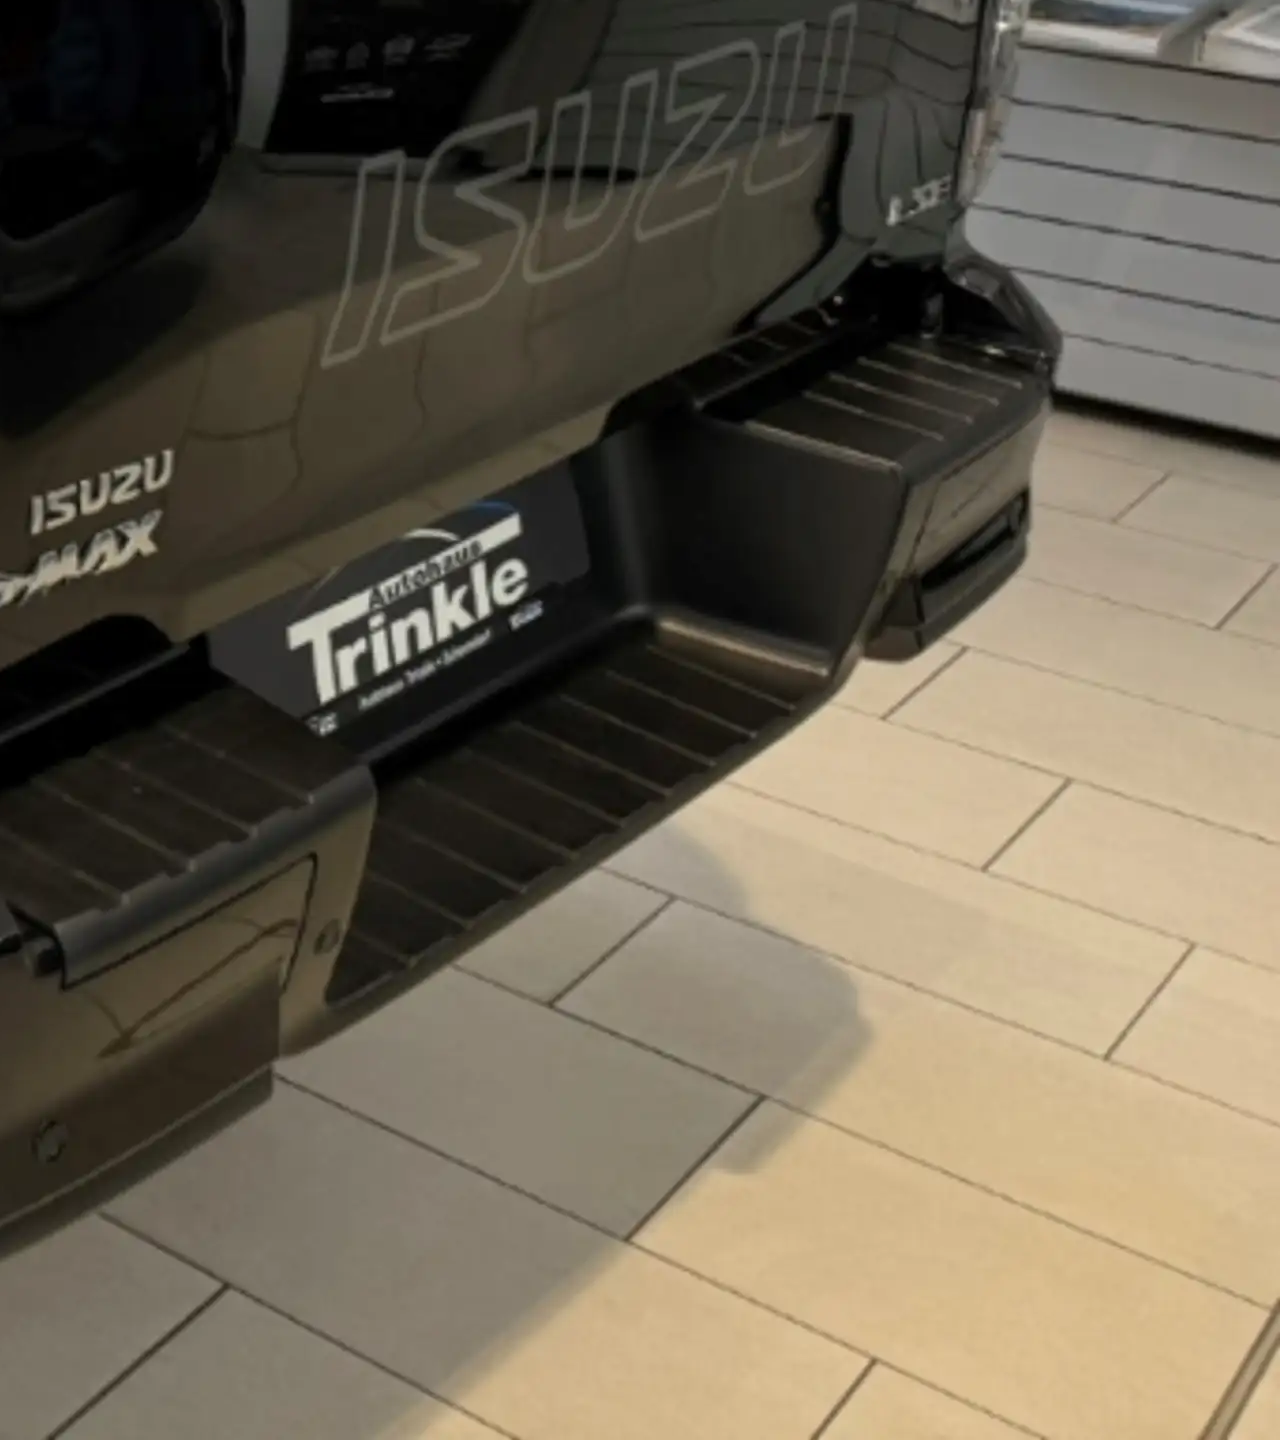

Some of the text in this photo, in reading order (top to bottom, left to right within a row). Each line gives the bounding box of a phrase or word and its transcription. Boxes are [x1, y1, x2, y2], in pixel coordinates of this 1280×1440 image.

[320, 2, 860, 371] ISUZU
[29, 447, 176, 537] ISUZU
[285, 510, 530, 707] Trinkle
[368, 539, 483, 611] Autohaus
